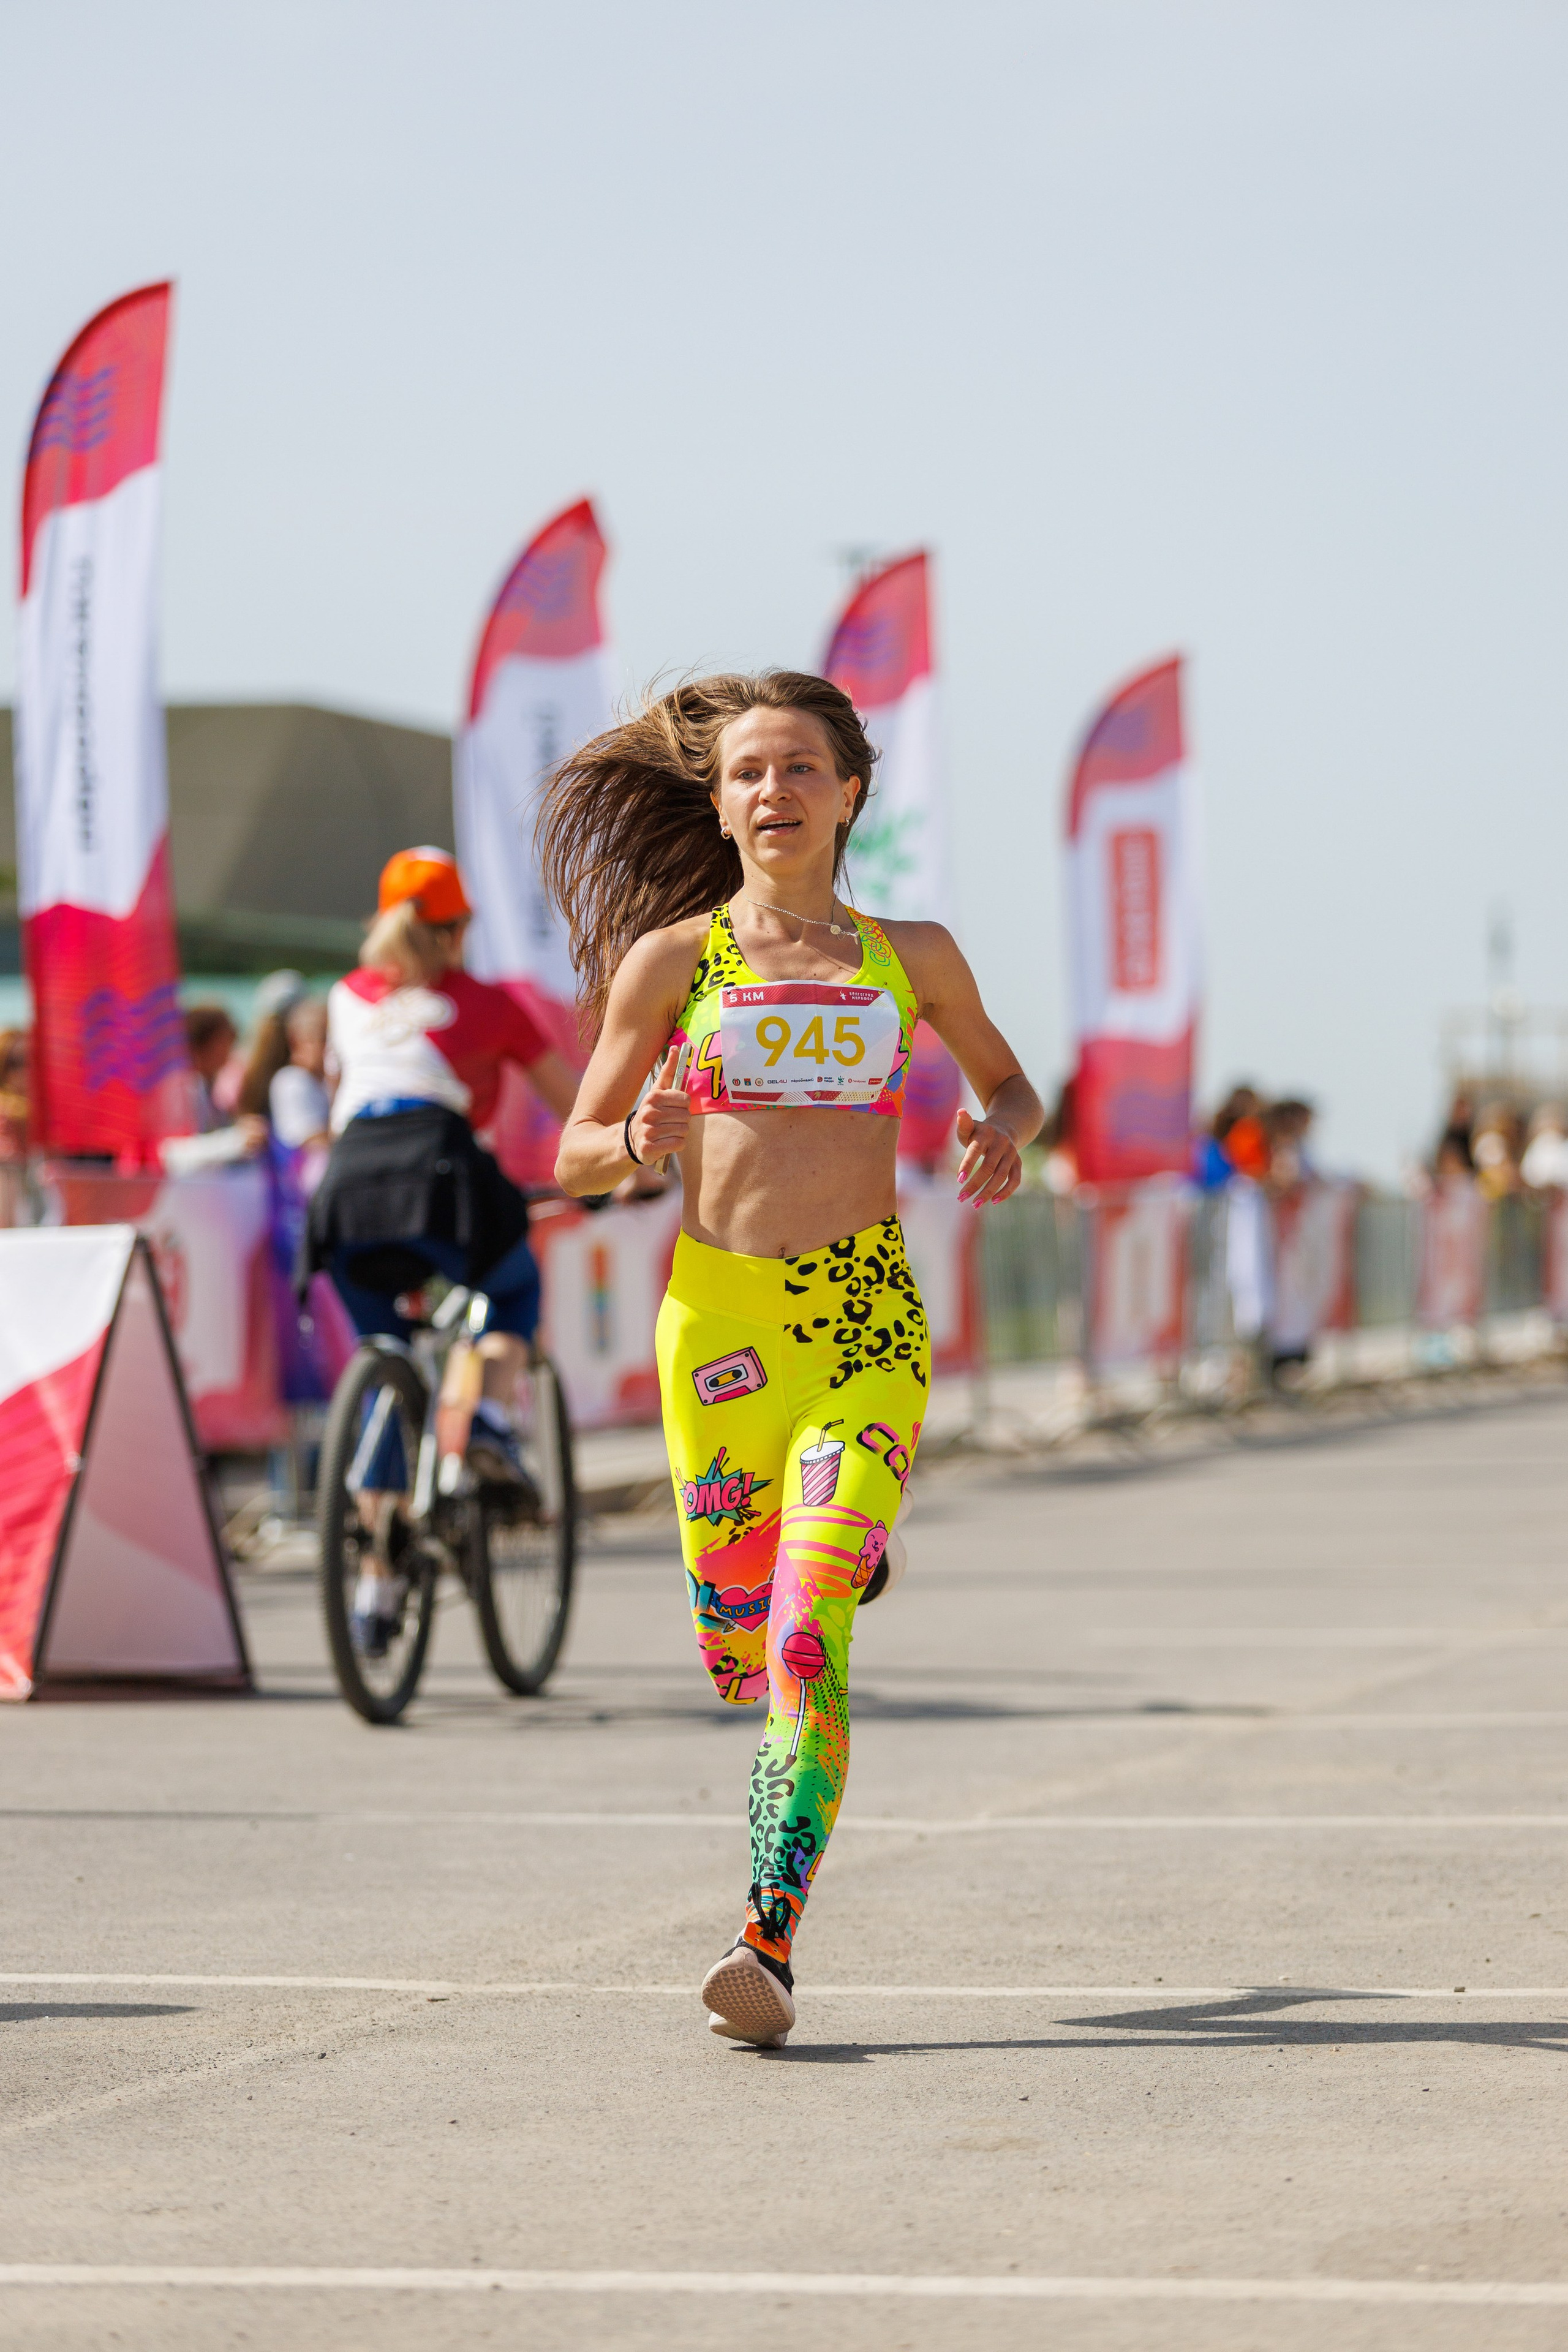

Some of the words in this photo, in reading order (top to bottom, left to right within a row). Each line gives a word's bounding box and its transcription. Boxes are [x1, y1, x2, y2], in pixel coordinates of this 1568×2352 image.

[729, 993, 738, 1003] 5
[755, 1016, 865, 1067] 945
[684, 1472, 755, 1515] OMG!
